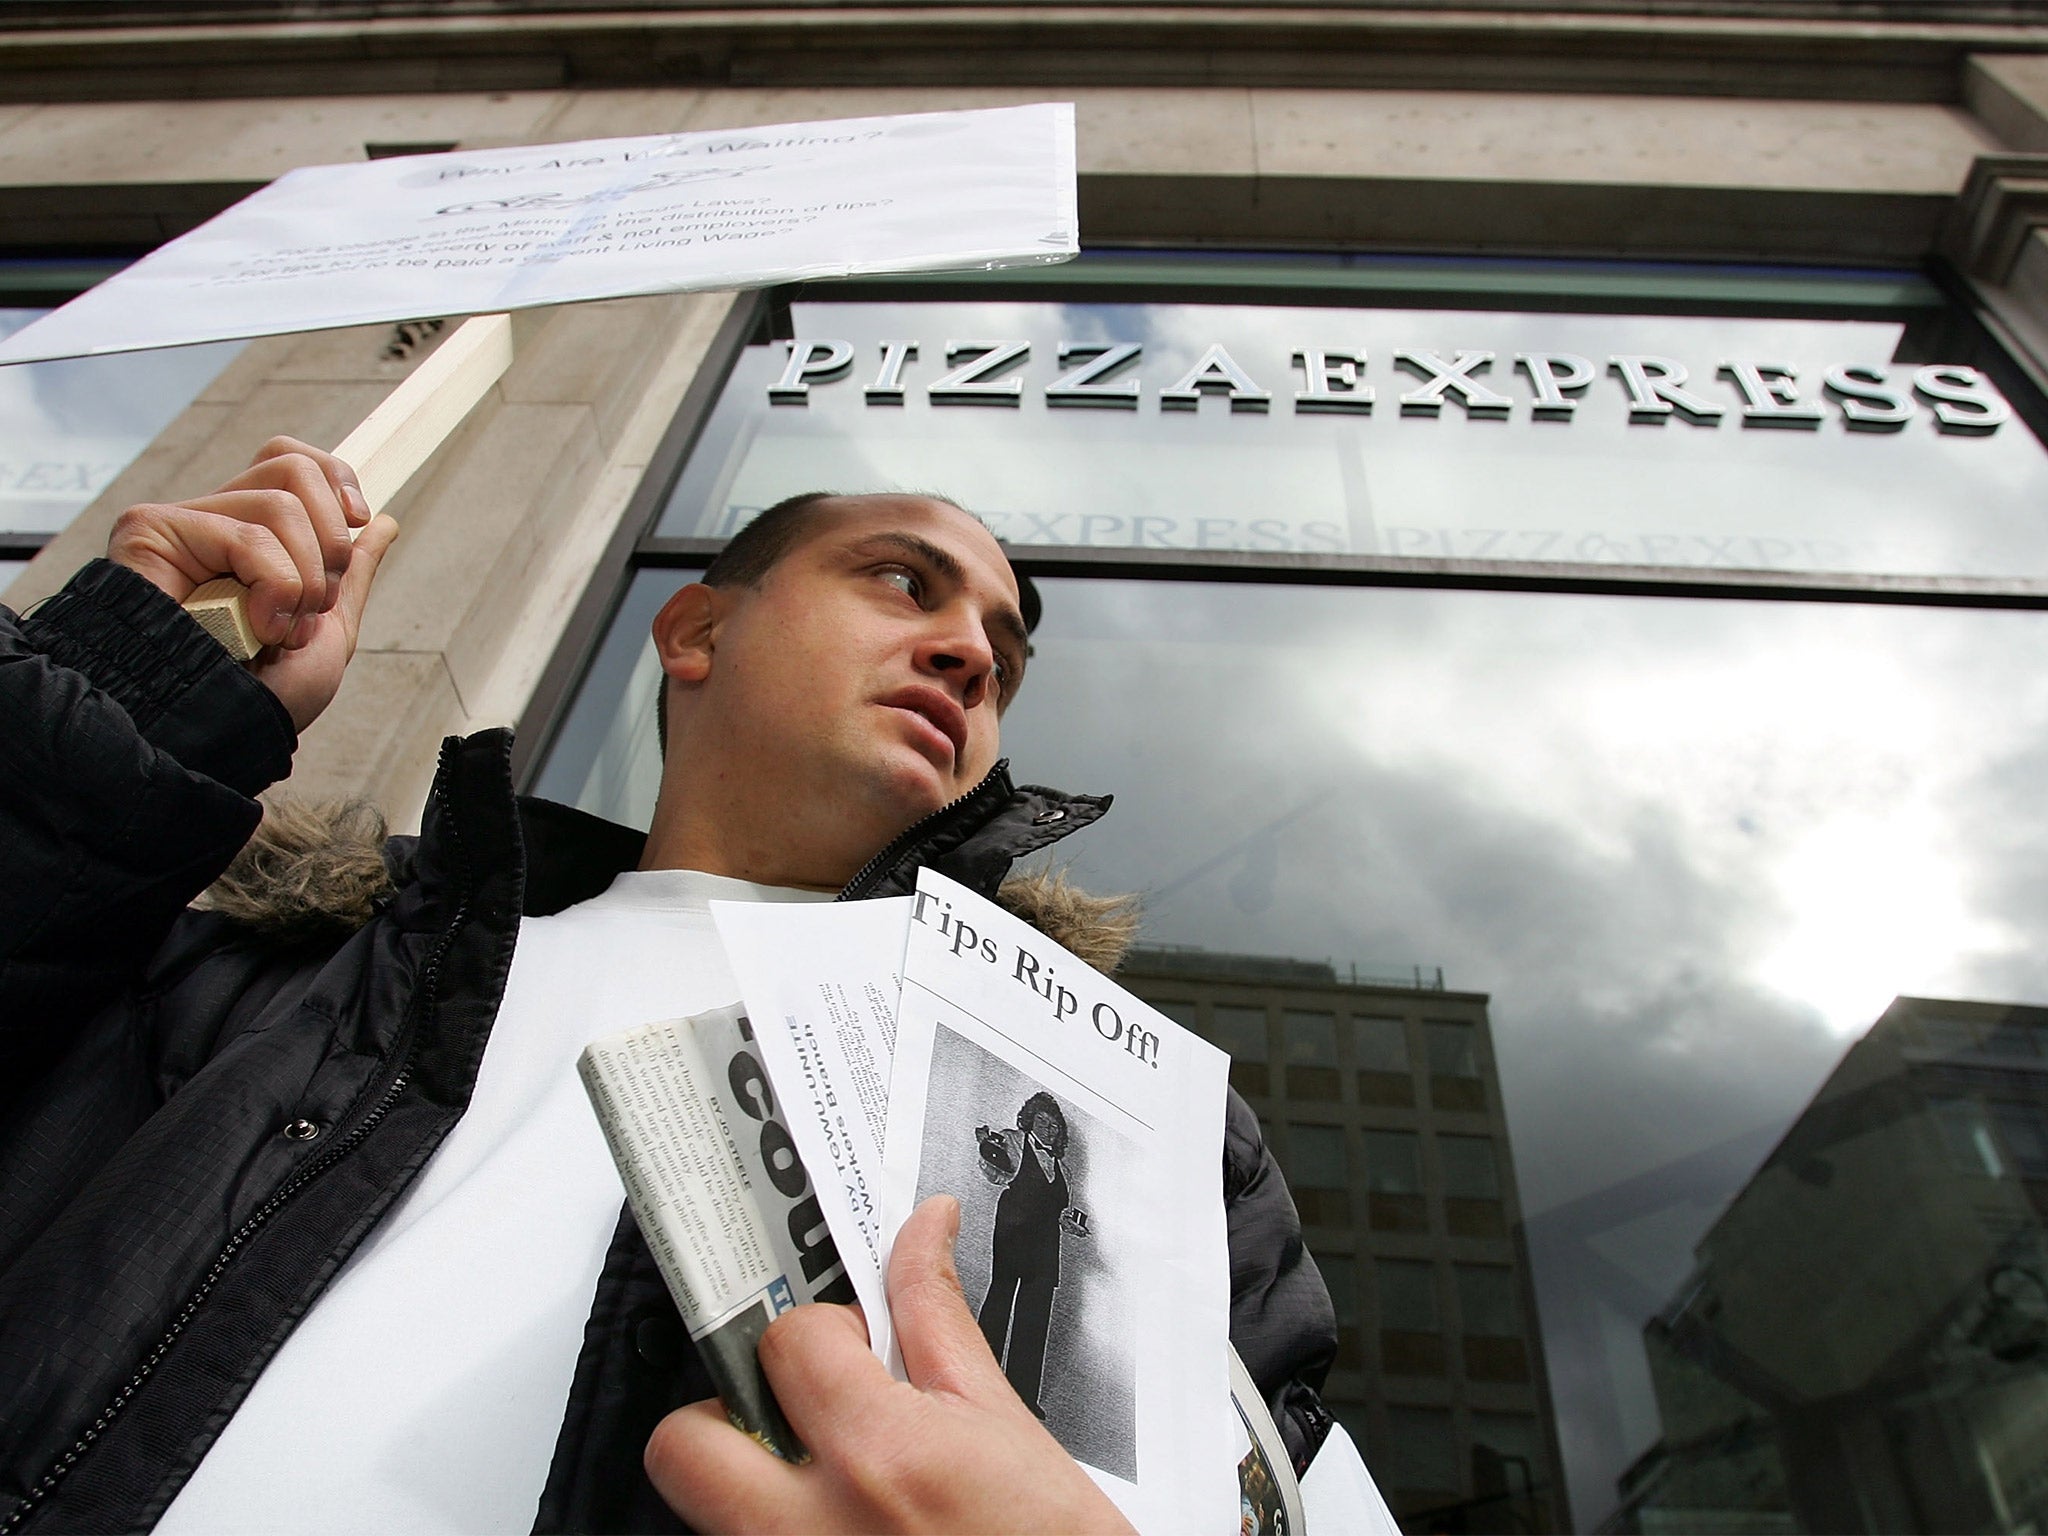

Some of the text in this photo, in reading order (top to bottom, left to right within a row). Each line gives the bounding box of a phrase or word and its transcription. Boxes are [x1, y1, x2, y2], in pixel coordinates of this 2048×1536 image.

[539, 158, 605, 169] Are
[707, 130, 884, 154] Waiting?
[503, 241, 532, 251] of
[597, 232, 613, 242] &
[623, 227, 662, 239] not
[670, 215, 818, 233] employers?
[616, 215, 652, 227] the
[661, 206, 794, 222] distribution
[803, 203, 828, 213] of
[835, 199, 894, 211] tips?
[693, 196, 772, 208] Laws?
[396, 256, 428, 267] be
[433, 255, 492, 270] paid
[618, 236, 692, 252] Living
[702, 227, 793, 243] Wage?
[836, 983, 857, 1029] practices
[863, 984, 874, 1002] you
[912, 889, 1160, 1069] Tips Rip Off!
[802, 1023, 837, 1107] Branch
[852, 1031, 867, 1061] unfair
[853, 1046, 881, 1113] campaigning
[864, 1063, 884, 1102] prevent
[639, 1066, 666, 1112] warned
[659, 1114, 696, 1178] yesterday.
[785, 1014, 847, 1176] TGWU-UNITE
[849, 1069, 874, 1125] represents
[853, 1066, 871, 1104] Central
[597, 1081, 624, 1126] damage,
[622, 1135, 645, 1165] study
[709, 1095, 752, 1190] BY JO STEELE
[598, 1048, 621, 1081] drinks
[615, 1082, 634, 1107] with
[627, 1108, 652, 1146] several
[646, 1147, 677, 1197] headache
[671, 1197, 694, 1234] tablets
[689, 1235, 702, 1255] can
[699, 1256, 724, 1301] increase
[615, 1050, 649, 1110] Combining
[645, 1111, 663, 1138] large
[656, 1139, 688, 1193] quantities
[683, 1194, 694, 1206] of
[690, 1208, 710, 1242] coffee
[712, 1258, 732, 1296] energy
[651, 1063, 692, 1140] paracetamol
[687, 1141, 708, 1177] could
[704, 1179, 716, 1197] be
[711, 1197, 737, 1244] deadly,
[730, 1245, 751, 1283] scien-
[671, 1074, 706, 1140] worldwide
[706, 1155, 719, 1175] but
[716, 1178, 739, 1224] mixing
[735, 1226, 761, 1278] caffeine
[680, 1069, 710, 1126] hangover
[706, 1128, 722, 1155] cure
[718, 1157, 734, 1185] used
[729, 1187, 742, 1205] by
[737, 1206, 763, 1257] millions
[758, 1258, 769, 1273] of
[834, 1115, 874, 1215] Workers
[844, 1183, 860, 1211] by
[603, 1120, 626, 1158] Sidney
[621, 1159, 646, 1201] Nelson,
[641, 1201, 660, 1227] who
[653, 1227, 669, 1246] led
[663, 1246, 678, 1265] the
[672, 1266, 702, 1315] research,
